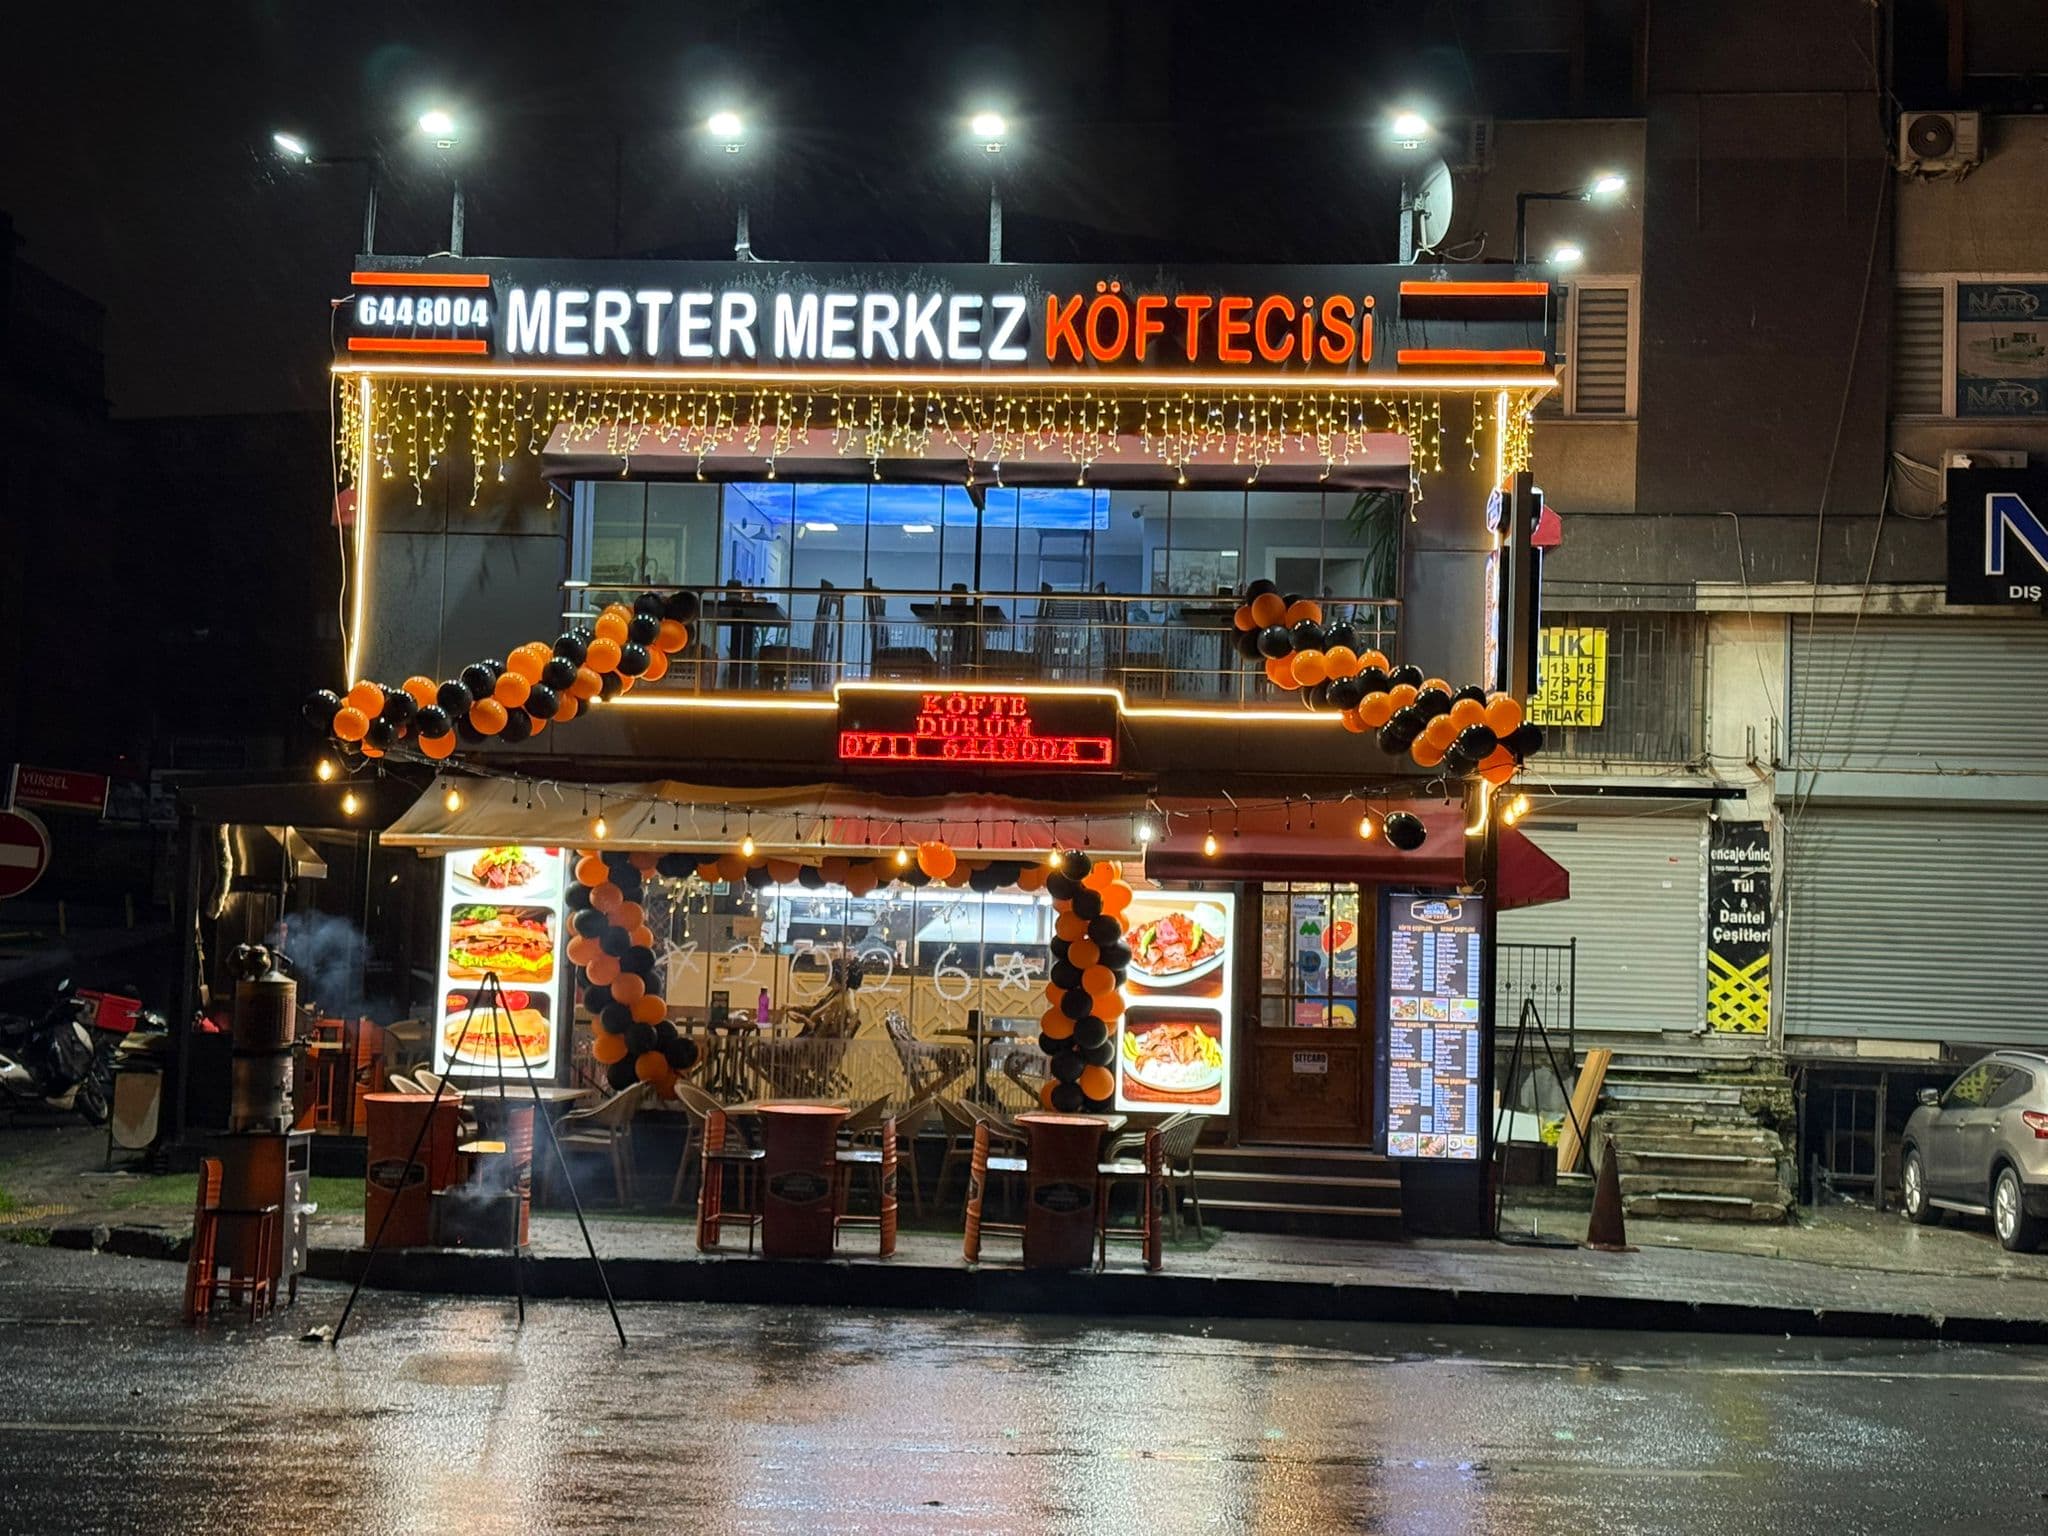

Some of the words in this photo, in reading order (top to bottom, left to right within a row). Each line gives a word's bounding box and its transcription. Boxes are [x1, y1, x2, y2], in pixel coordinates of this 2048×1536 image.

[507, 288, 758, 359] MERTER
[773, 291, 1028, 363] MERKEZ
[2009, 585, 2042, 601] DIŞ
[1578, 663, 1595, 674] 18
[922, 692, 1028, 716] KÖFTE
[1532, 709, 1585, 722] EMLAK
[916, 714, 1033, 738] DÜRÜM
[1731, 878, 1754, 893] Tül
[1719, 909, 1765, 924] Dantel
[1712, 927, 1771, 944] Çeşitleri
